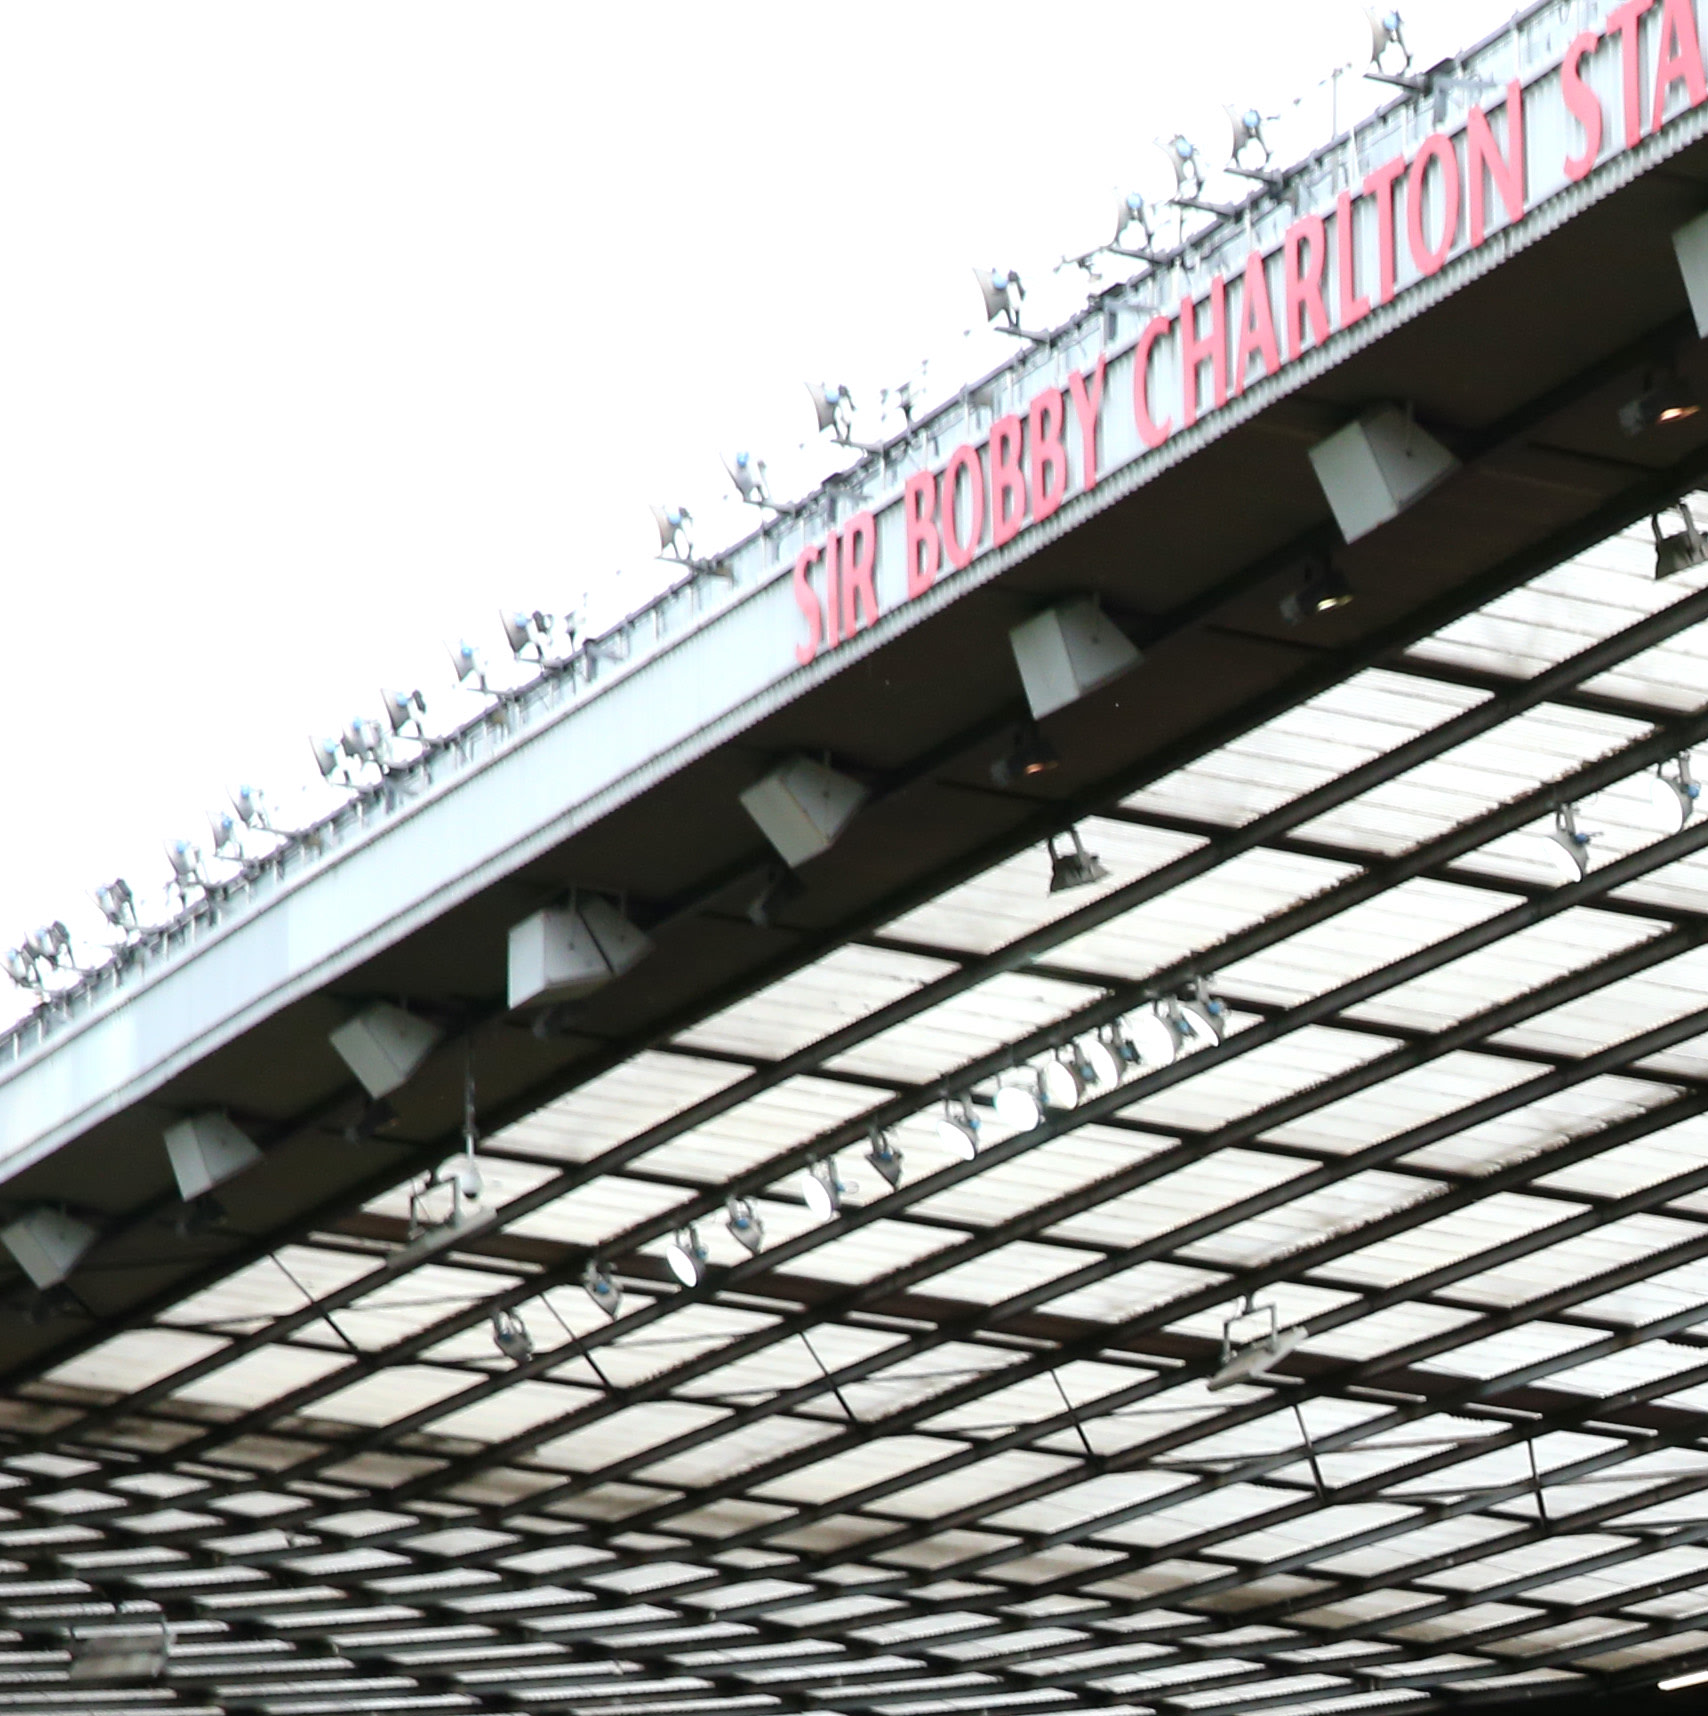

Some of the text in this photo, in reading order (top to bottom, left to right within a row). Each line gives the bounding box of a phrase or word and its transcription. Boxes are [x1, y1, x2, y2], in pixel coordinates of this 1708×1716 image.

[796, 511, 878, 664] SIR
[904, 353, 1106, 601] BOBBY
[1133, 81, 1526, 451] CHARLTON
